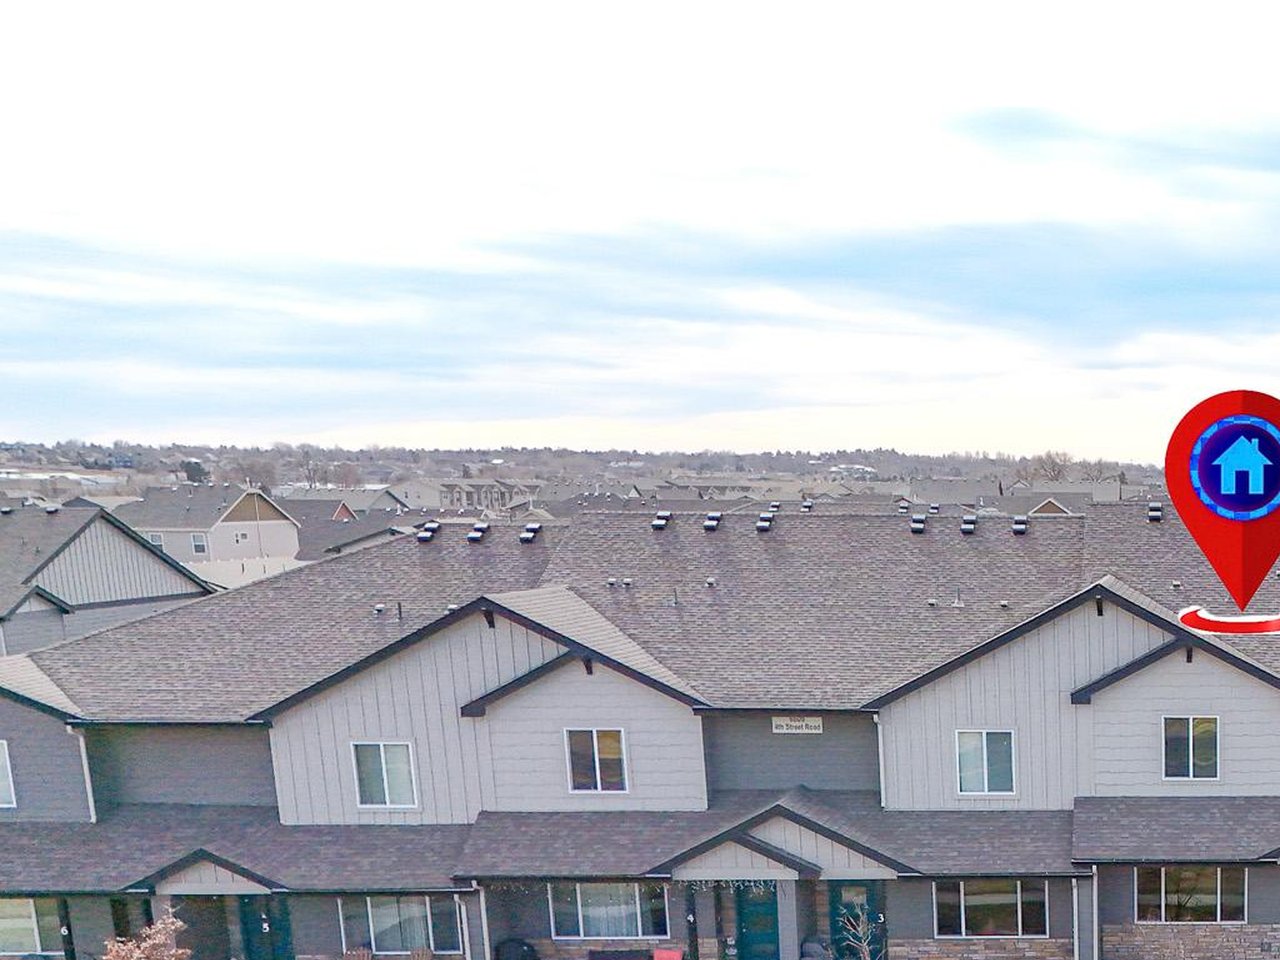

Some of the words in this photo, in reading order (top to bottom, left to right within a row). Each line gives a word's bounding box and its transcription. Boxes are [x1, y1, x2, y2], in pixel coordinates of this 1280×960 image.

[785, 723, 804, 731] Street
[804, 723, 821, 732] Road
[686, 914, 695, 923] 4
[877, 913, 885, 923] 3
[60, 925, 69, 936] 6
[262, 922, 270, 933] 5
